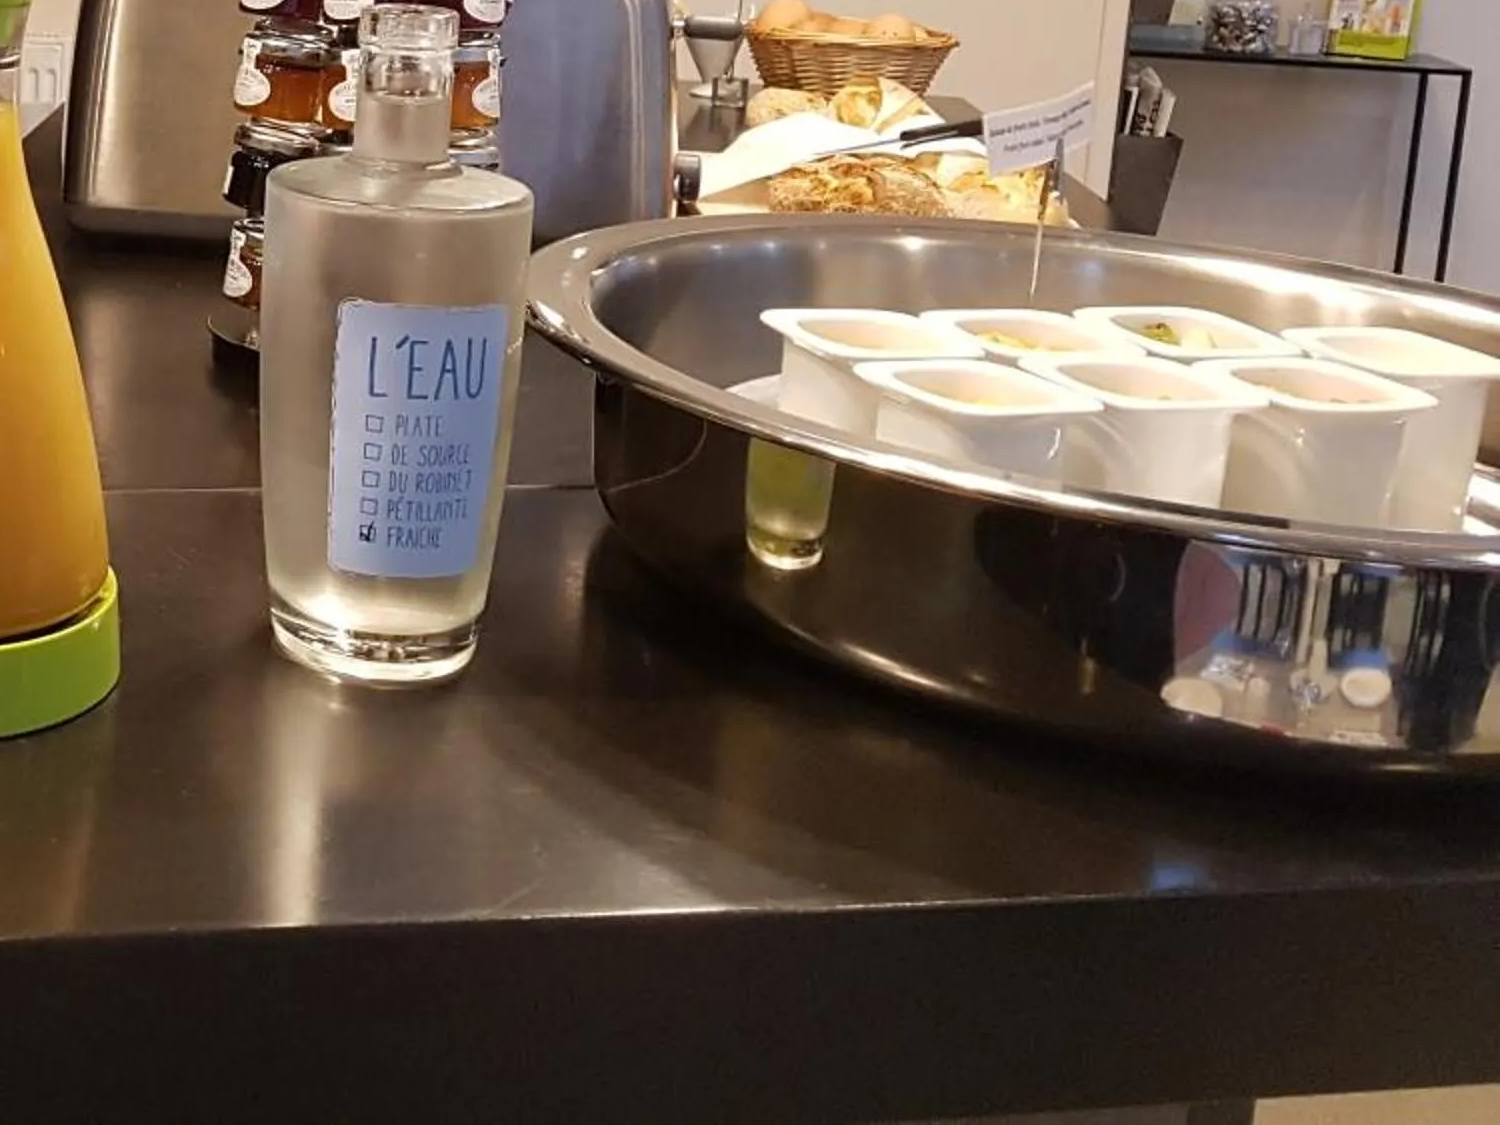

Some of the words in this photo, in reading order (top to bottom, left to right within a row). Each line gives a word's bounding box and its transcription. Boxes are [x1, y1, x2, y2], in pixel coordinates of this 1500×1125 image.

[395, 414, 444, 436] PLATE
[391, 444, 408, 466] DE
[418, 444, 469, 467] SOURCE
[389, 470, 408, 493] DU
[415, 469, 472, 493] ROBINET
